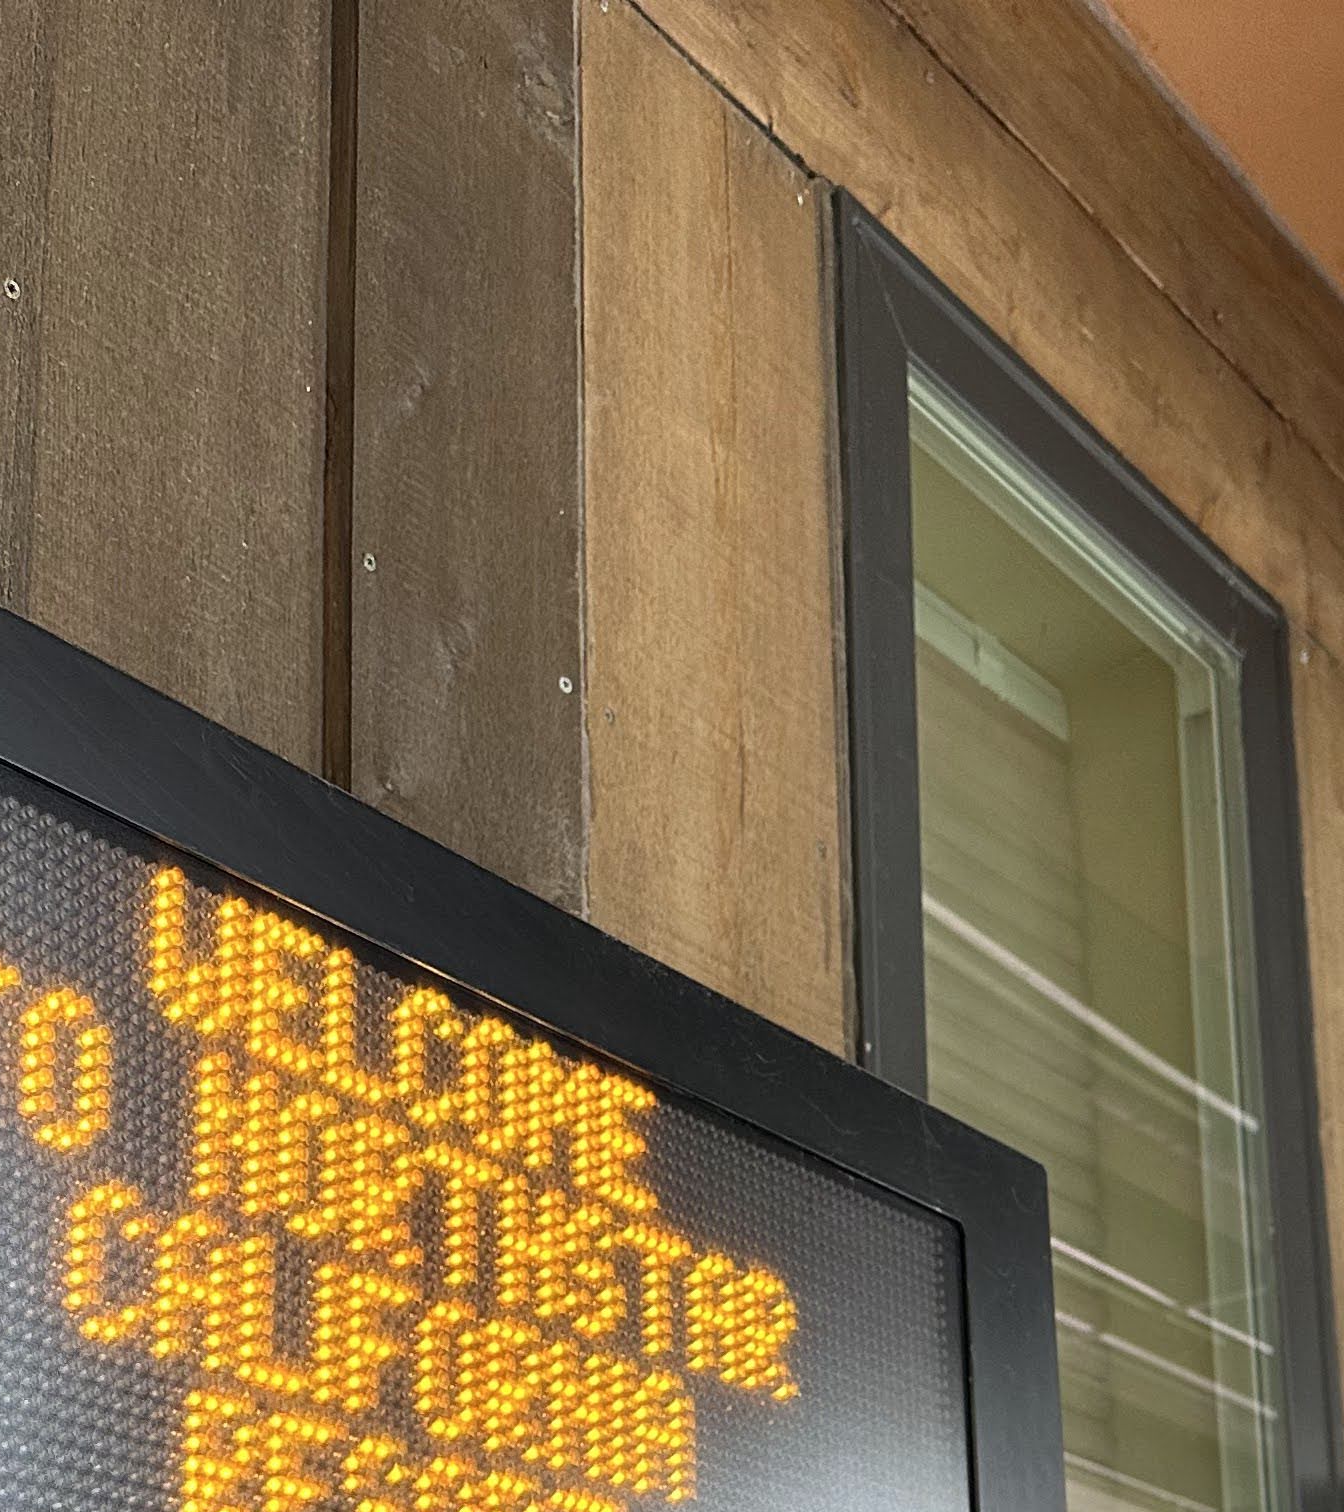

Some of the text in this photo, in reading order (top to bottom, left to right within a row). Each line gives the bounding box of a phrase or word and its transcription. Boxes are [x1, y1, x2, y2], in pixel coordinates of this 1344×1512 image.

[146, 865, 659, 1211] WELCOME
[63, 1181, 698, 1503] CALIFORNIA
[194, 1050, 799, 1400] NORTHSTAR
